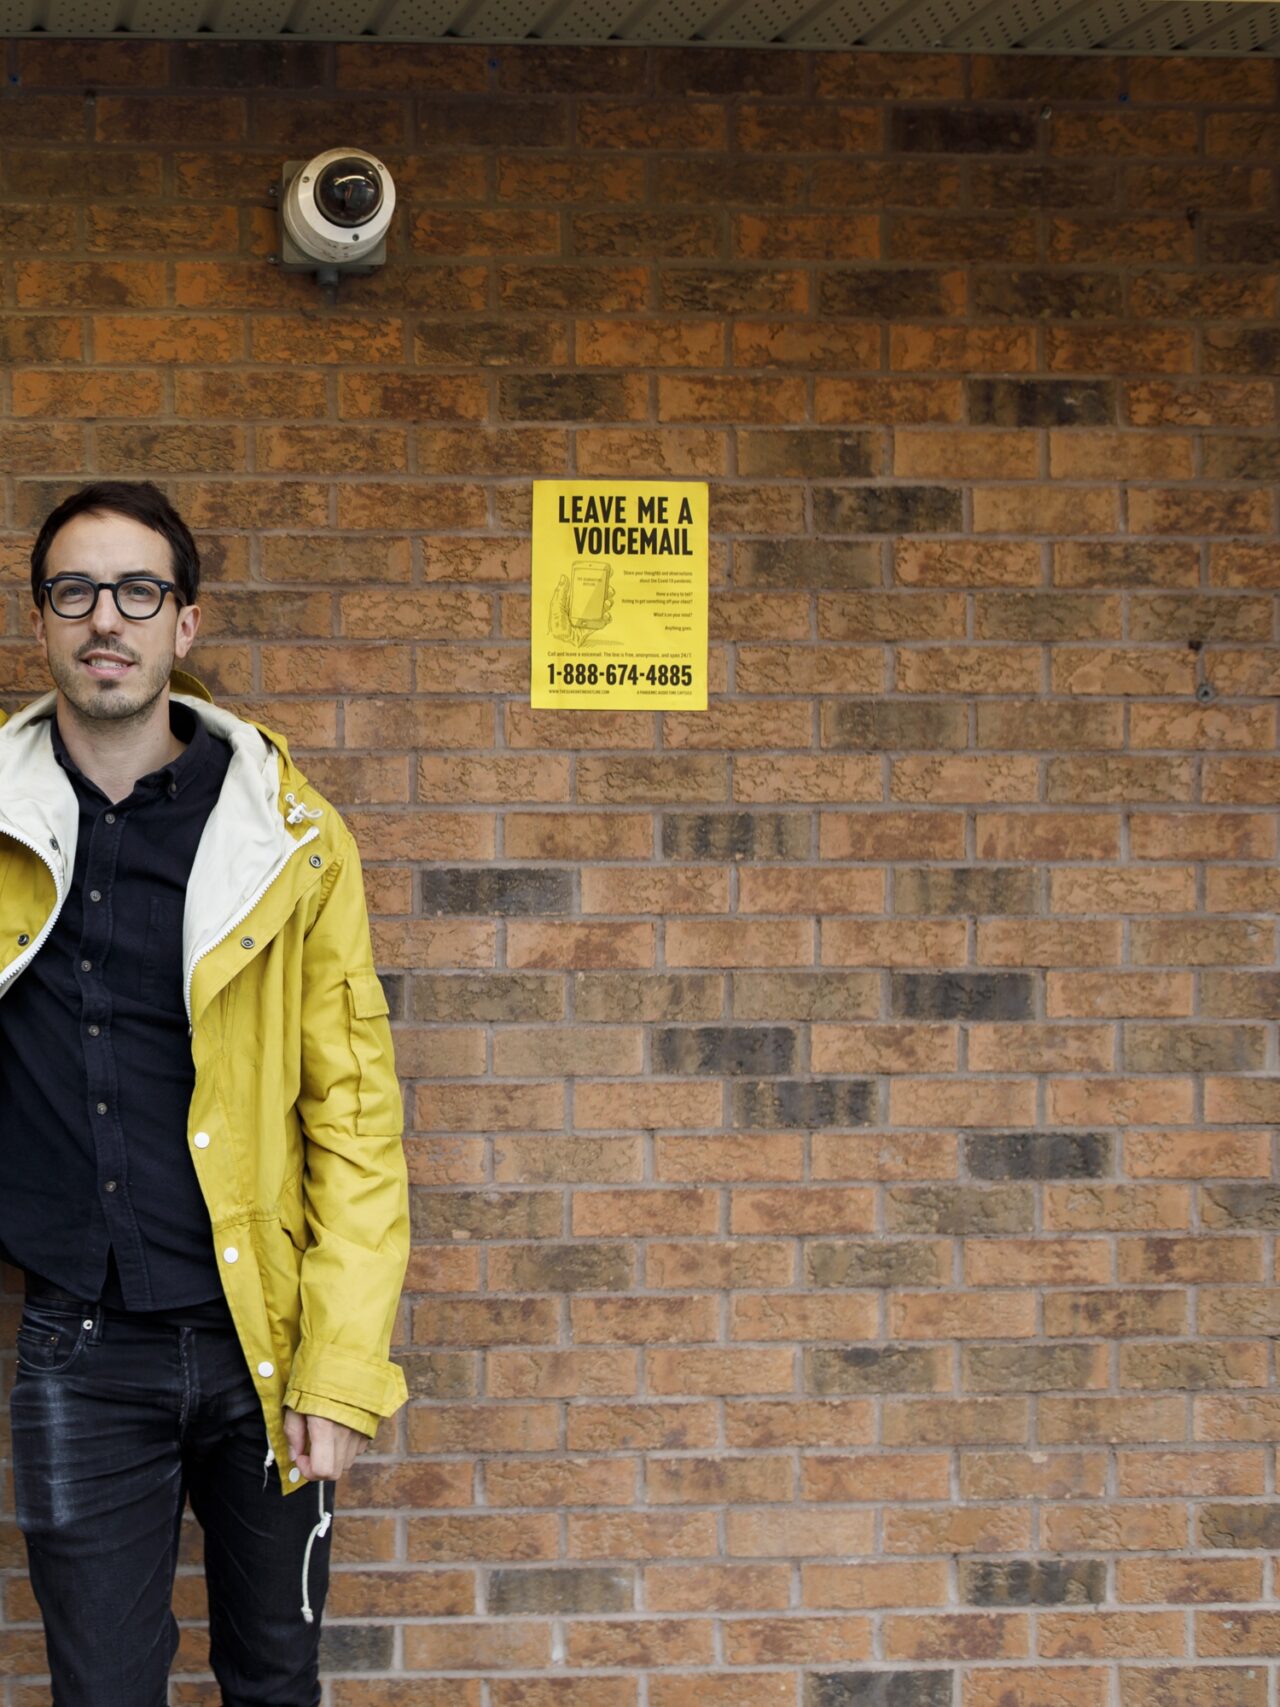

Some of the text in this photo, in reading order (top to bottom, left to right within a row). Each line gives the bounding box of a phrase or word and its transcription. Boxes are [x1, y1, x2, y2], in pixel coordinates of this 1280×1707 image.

[558, 495, 693, 525] LEAVE ME A
[573, 526, 693, 556] VOICEMAIL
[547, 663, 693, 687] 1-888-674-4885
